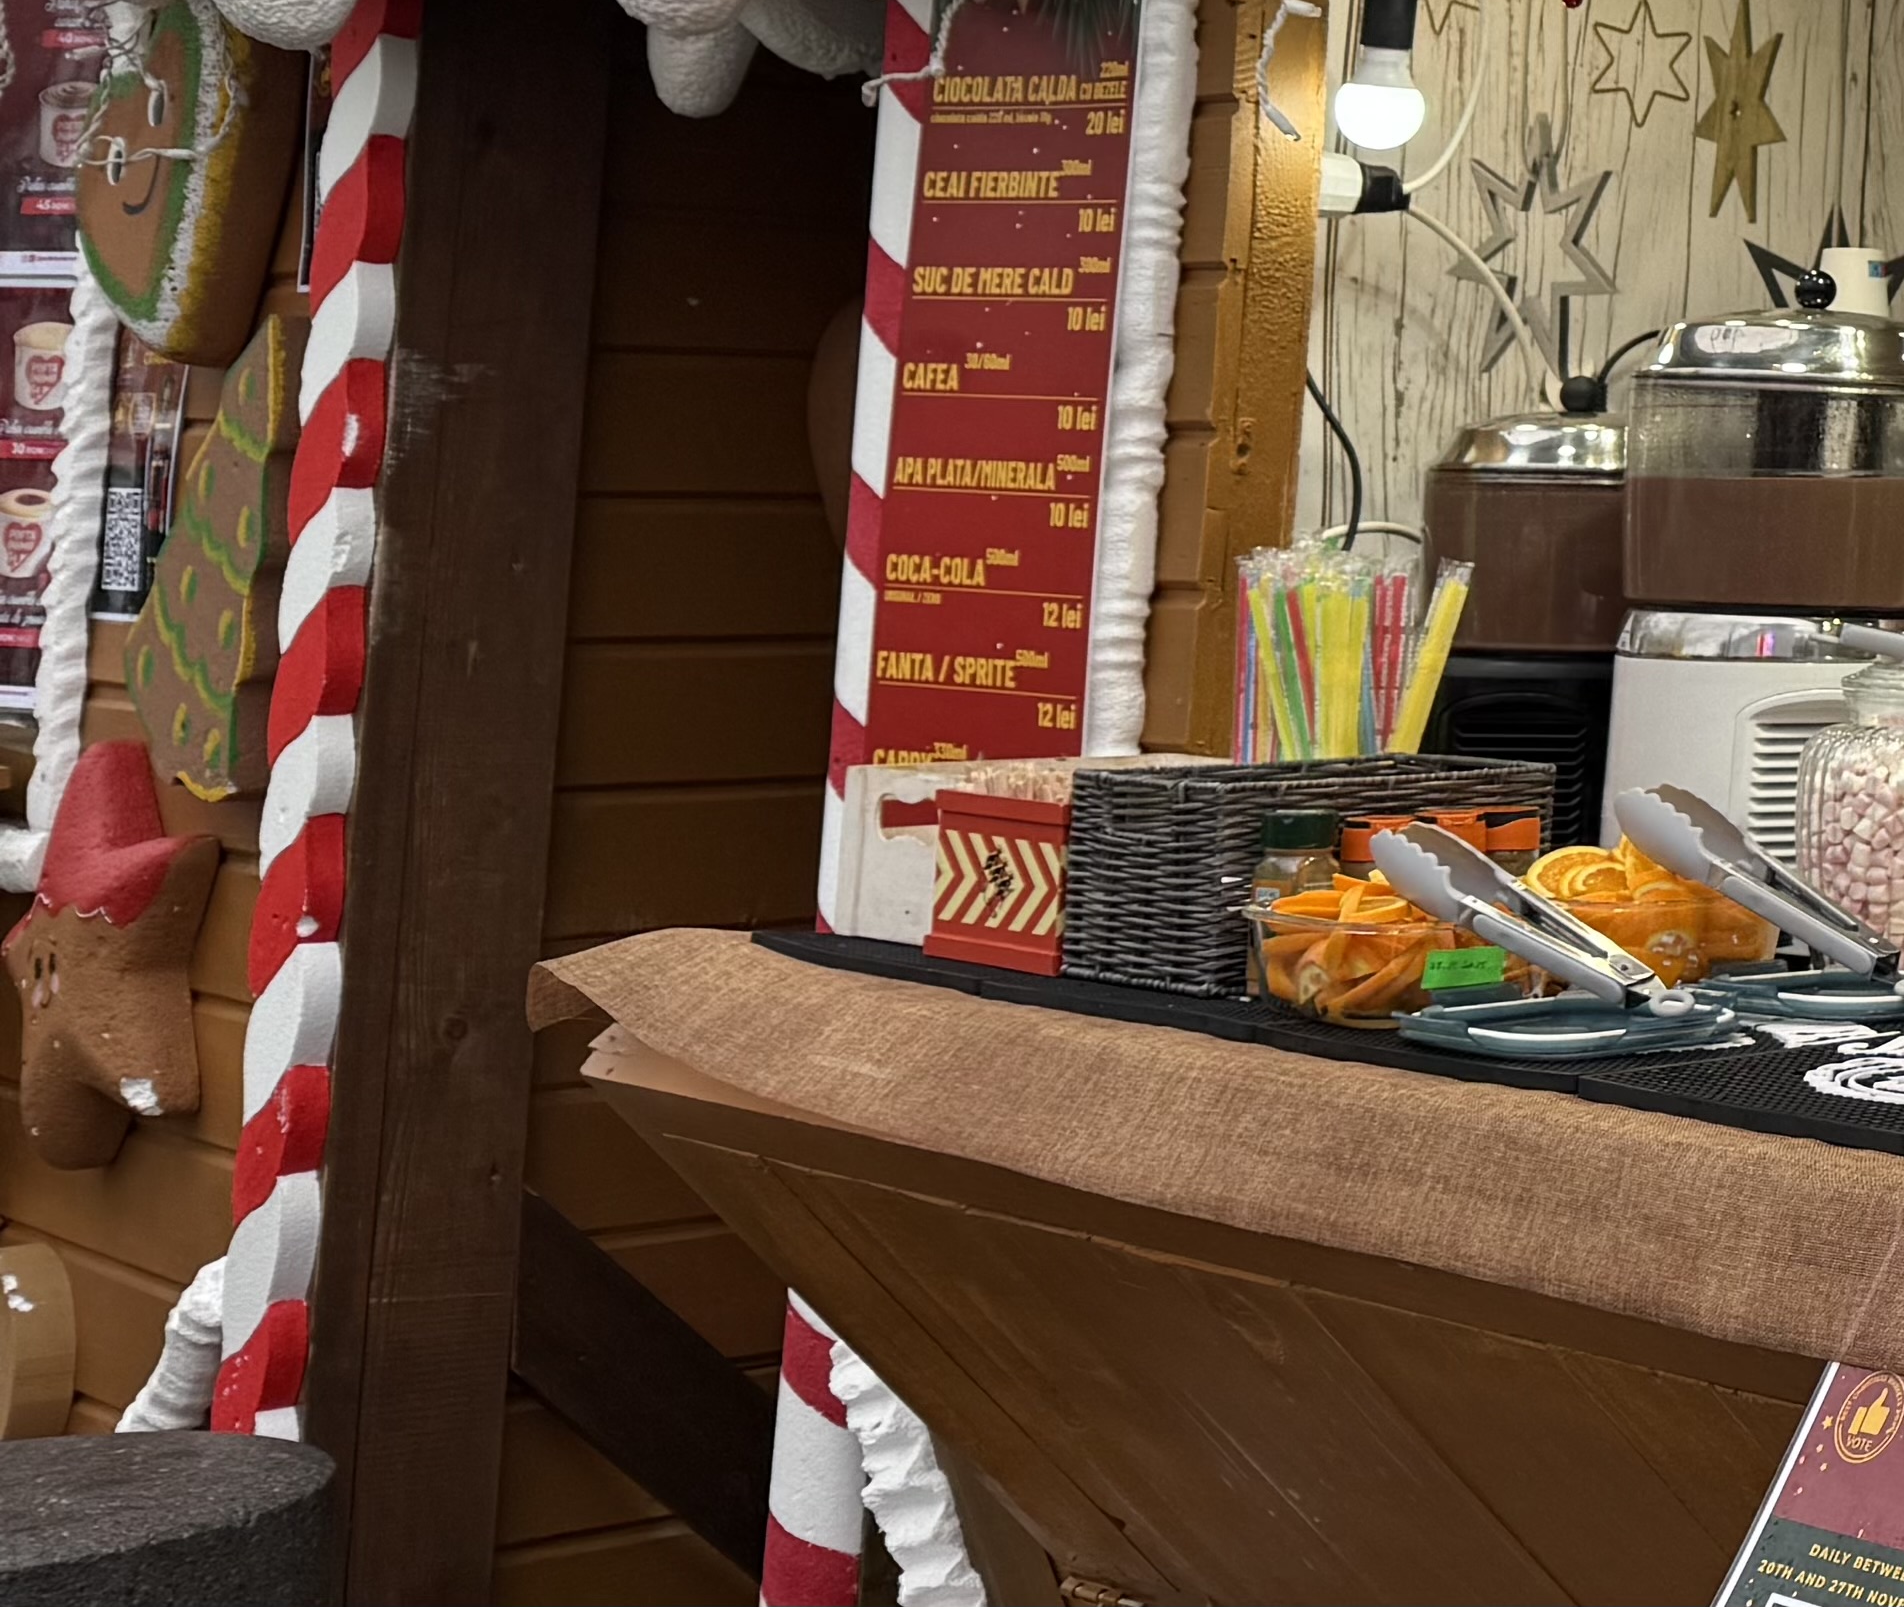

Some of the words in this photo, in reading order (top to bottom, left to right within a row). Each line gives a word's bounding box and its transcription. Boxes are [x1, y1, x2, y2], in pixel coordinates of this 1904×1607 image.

[933, 76, 1024, 103] CIOCOLATA
[1027, 75, 1076, 102] CALDA
[1085, 112, 1102, 135] 20
[1107, 110, 1125, 134] lei
[923, 171, 966, 198] CEAI
[969, 171, 1061, 198] FIERBINTE
[1078, 208, 1092, 232] 10
[1096, 207, 1116, 232] lei
[912, 266, 948, 293] SUC
[951, 267, 976, 293] DE
[977, 267, 1026, 294] MERE
[1028, 268, 1074, 295] CALD
[1067, 307, 1082, 330] 10
[1086, 305, 1106, 331] lei
[903, 363, 960, 390] CAFEA
[1057, 405, 1073, 430] 10
[1076, 405, 1097, 430] lei
[893, 457, 923, 484] APA
[927, 458, 1056, 490] PLATA/MINERALA
[1050, 503, 1065, 527] 10
[1068, 503, 1089, 528] lei
[886, 554, 986, 586] COCA-COLA
[1043, 603, 1059, 627] 12
[1062, 604, 1082, 629] lei
[877, 651, 934, 682] FANTA
[954, 657, 1016, 688] SPRITE
[1038, 703, 1053, 728] 12
[1056, 704, 1076, 729] lei
[1846, 1436, 1873, 1452] VOTE
[1809, 1544, 1852, 1565] DAILY
[1757, 1560, 1794, 1580] 20TH
[1794, 1571, 1827, 1589] AND
[1828, 1580, 1865, 1600] 27TH
